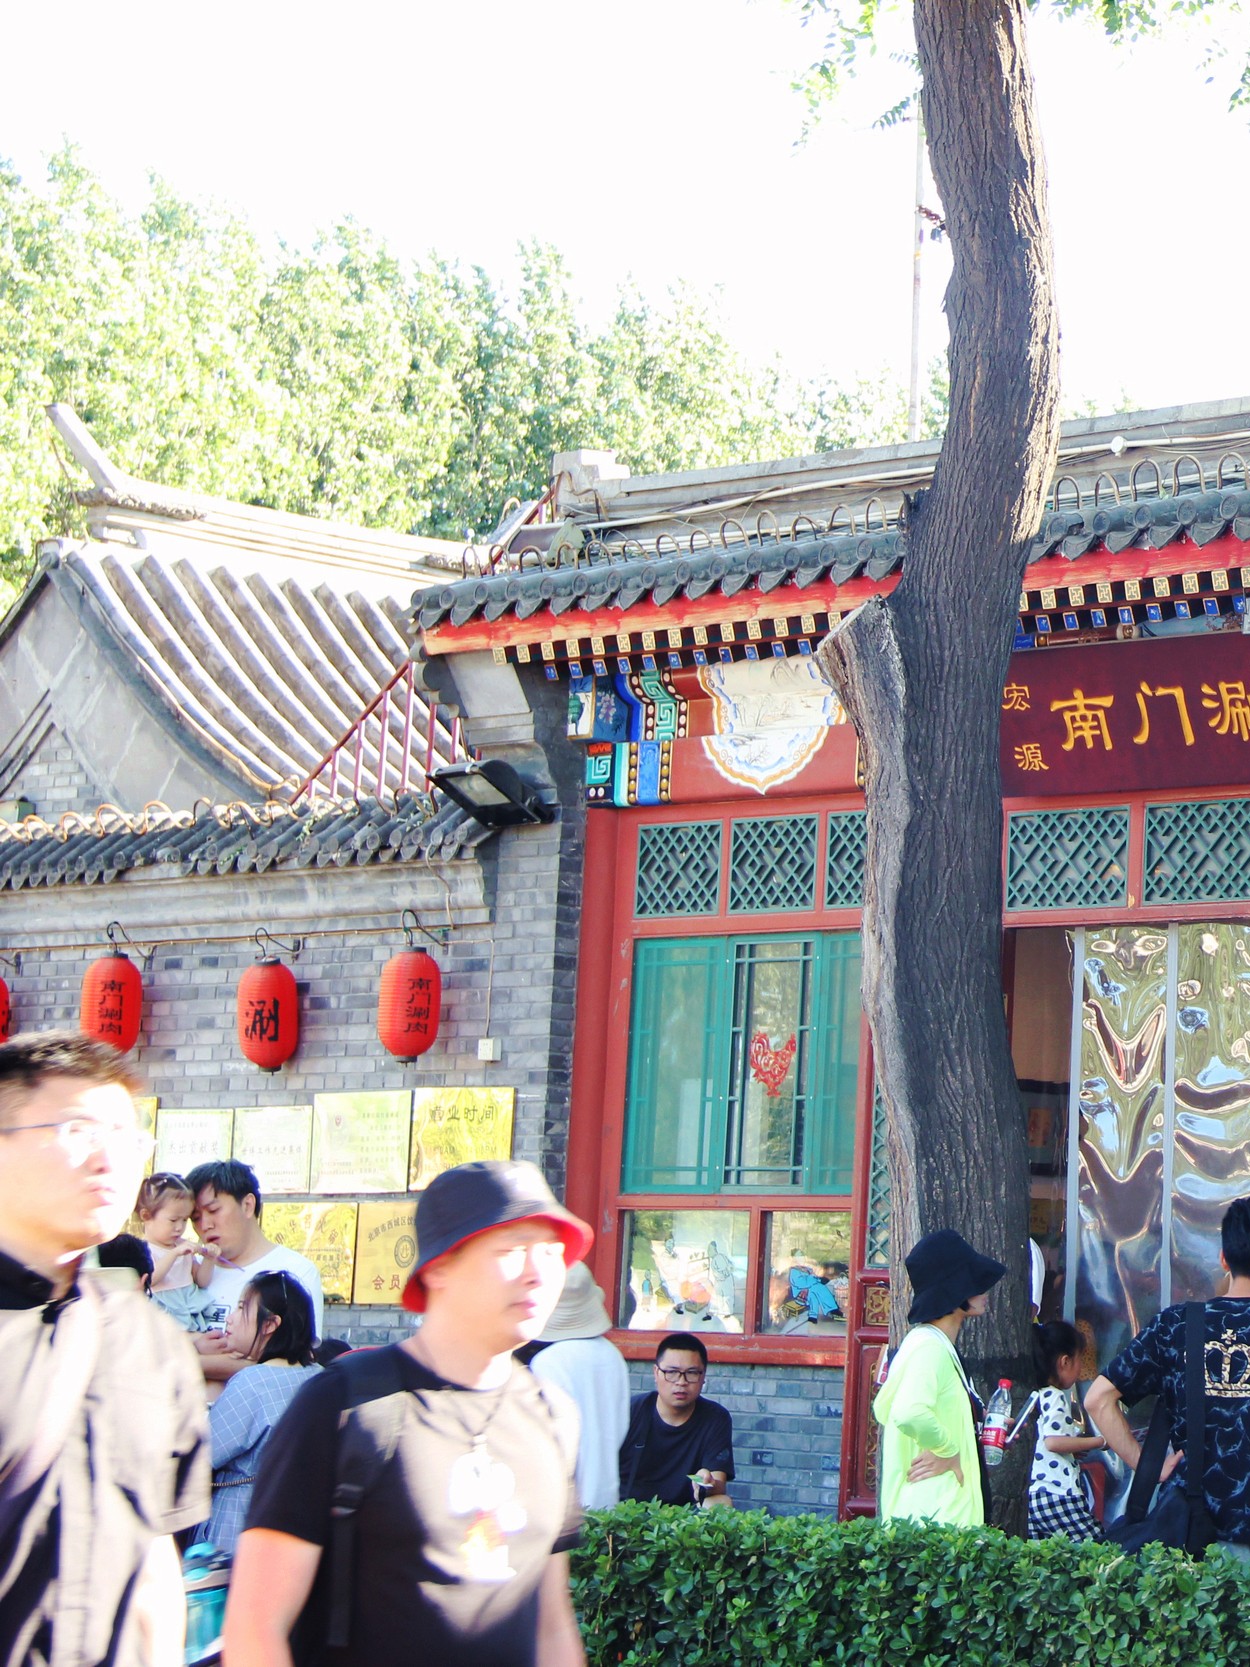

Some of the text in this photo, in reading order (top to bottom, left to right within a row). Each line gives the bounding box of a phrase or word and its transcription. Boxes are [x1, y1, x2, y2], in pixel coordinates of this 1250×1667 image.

[1002, 681, 1049, 772] 宏源
[98, 979, 127, 1036] 南门涮肉
[244, 996, 279, 1042] 涮
[403, 977, 432, 1035] 南门涮肉
[430, 1104, 495, 1124] 营业时间
